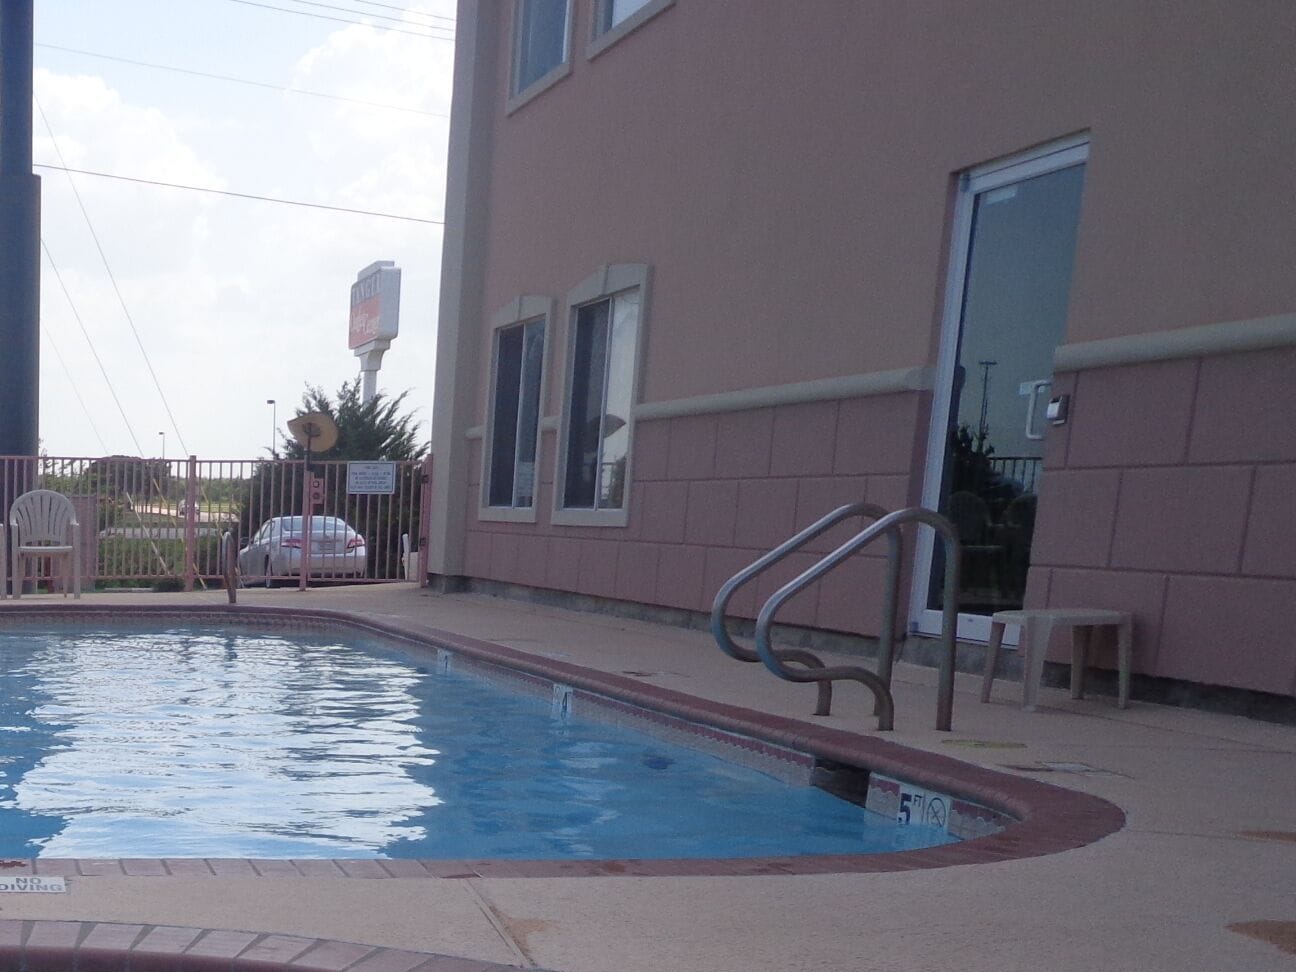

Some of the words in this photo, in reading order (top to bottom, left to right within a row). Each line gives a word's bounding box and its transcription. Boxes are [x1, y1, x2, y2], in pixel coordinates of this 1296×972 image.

[897, 792, 913, 826] 5
[913, 794, 923, 808] FT
[15, 877, 42, 886] NO
